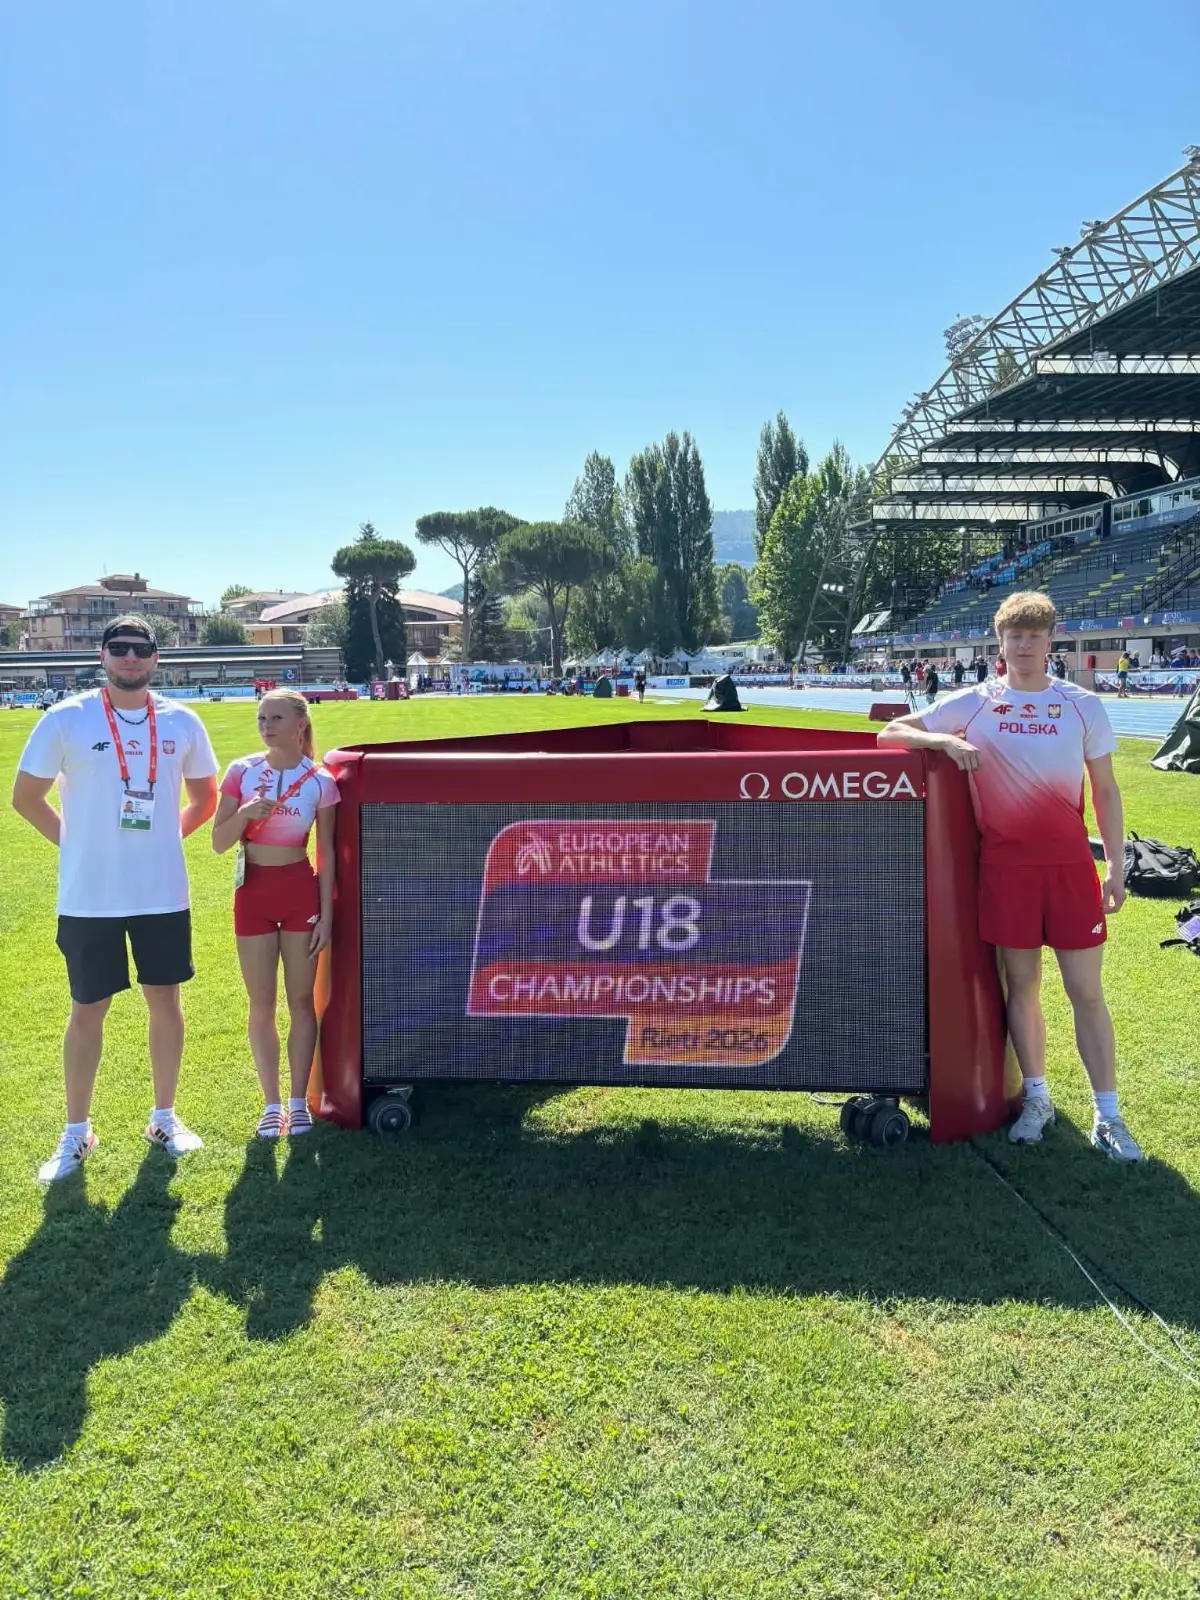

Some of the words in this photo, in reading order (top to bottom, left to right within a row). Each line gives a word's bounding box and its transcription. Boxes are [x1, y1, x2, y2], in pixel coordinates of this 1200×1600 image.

[992, 704, 1014, 715] 4F
[999, 722, 1058, 736] POLSKA
[92, 742, 111, 752] 4F
[781, 771, 918, 799] OMEGA
[558, 833, 690, 854] EUROPEAN
[558, 853, 690, 874] ATHLETICS
[577, 894, 702, 952] U18
[488, 973, 776, 1004] CHAMPIONSHIPS
[640, 1028, 700, 1049] Rieti
[705, 1029, 769, 1052] 2026
